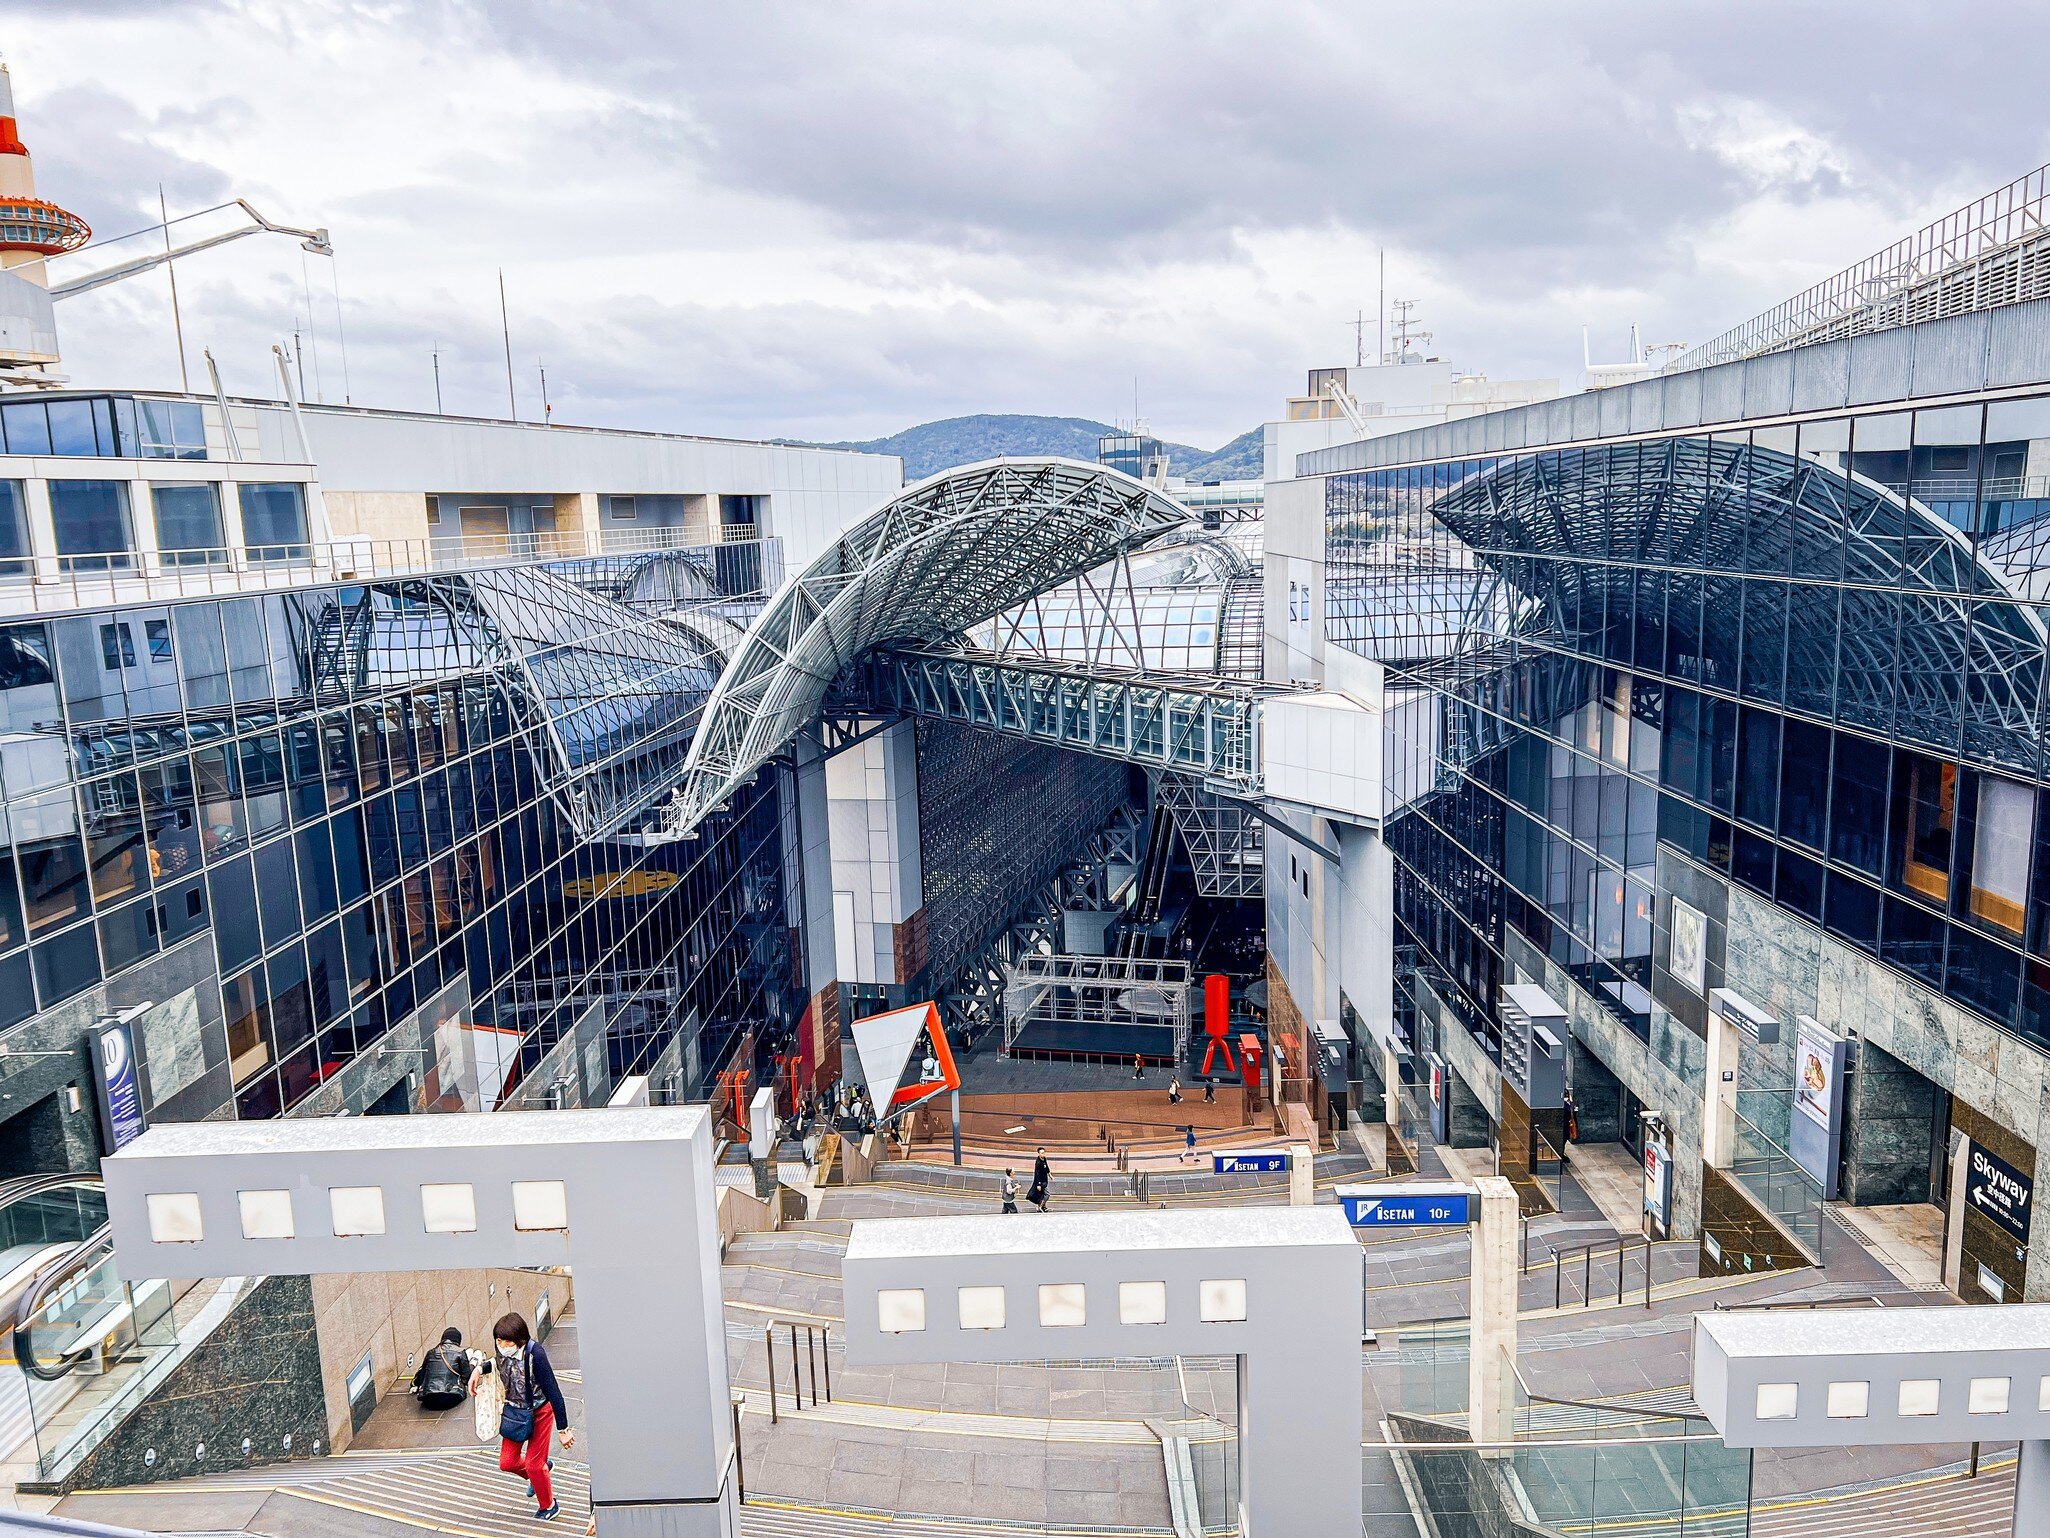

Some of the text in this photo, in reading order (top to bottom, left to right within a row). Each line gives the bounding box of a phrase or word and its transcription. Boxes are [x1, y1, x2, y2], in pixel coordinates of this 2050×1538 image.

[1268, 1160, 1281, 1171] 9F
[1973, 1151, 2028, 1207] Skyway
[1360, 1203, 1369, 1213] JR
[1428, 1208, 1451, 1219] 10F
